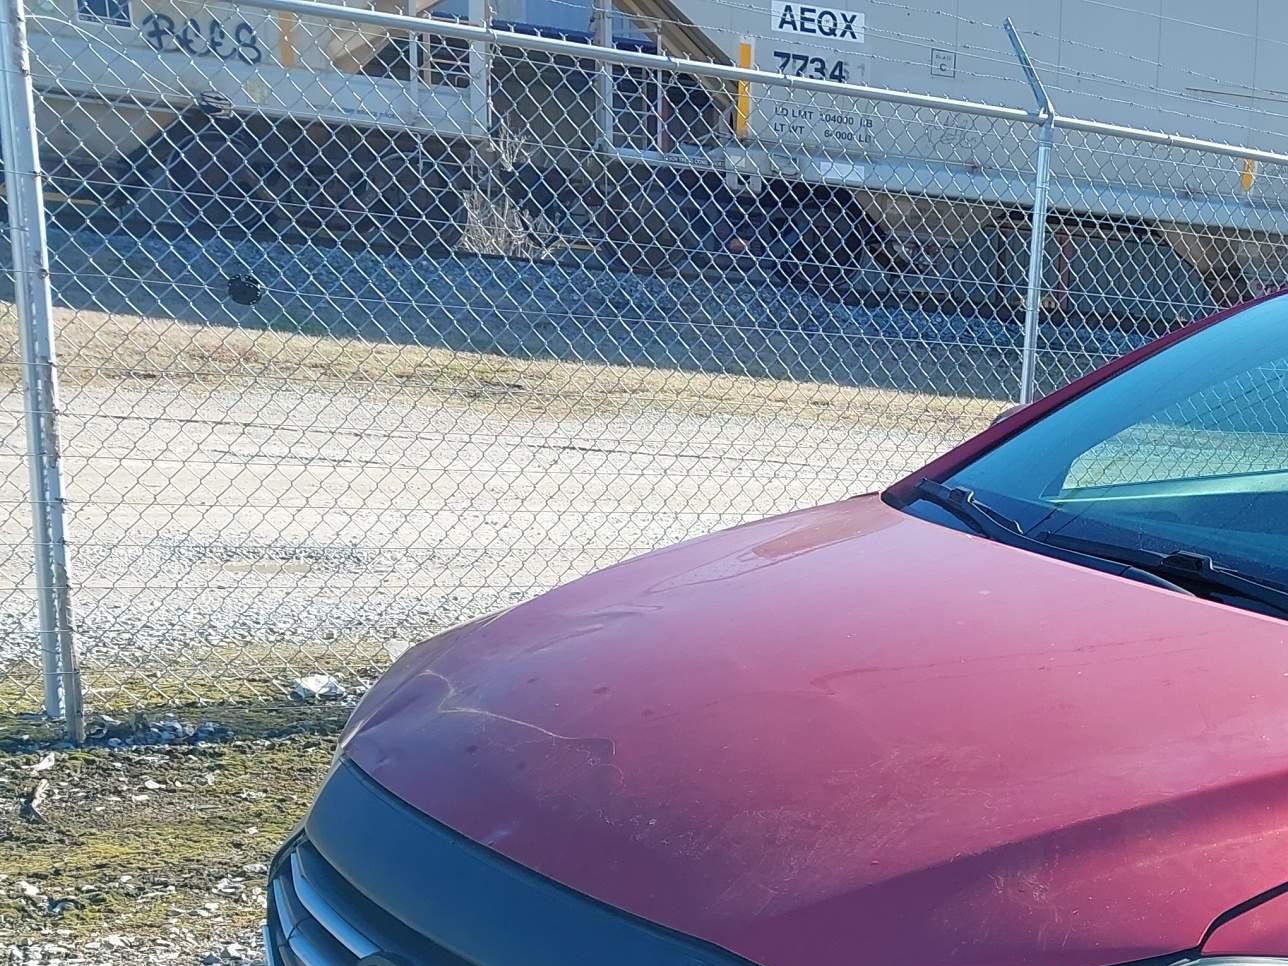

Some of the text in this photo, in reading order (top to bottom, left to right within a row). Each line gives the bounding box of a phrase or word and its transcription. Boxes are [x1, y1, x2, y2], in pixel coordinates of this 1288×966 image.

[778, 4, 857, 40] AEQX
[773, 50, 846, 83] 7734
[773, 122, 786, 132] LT
